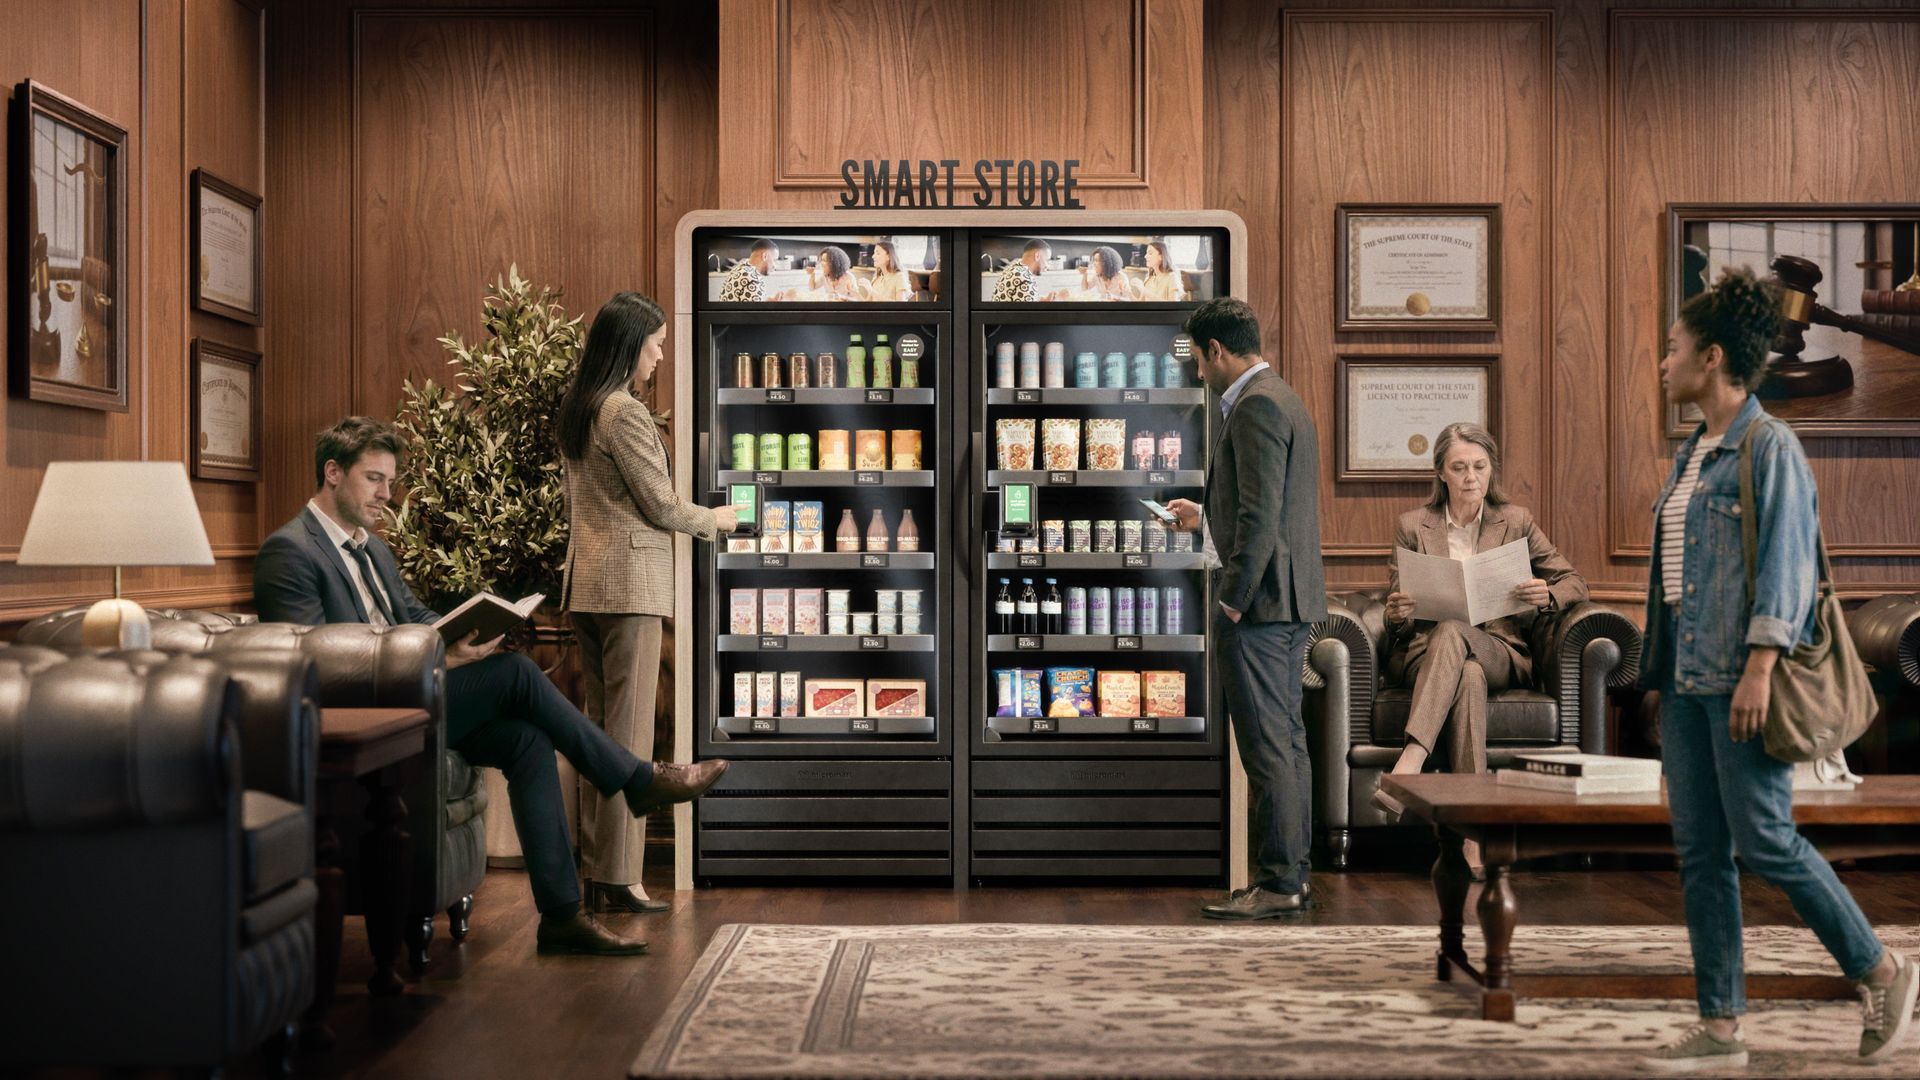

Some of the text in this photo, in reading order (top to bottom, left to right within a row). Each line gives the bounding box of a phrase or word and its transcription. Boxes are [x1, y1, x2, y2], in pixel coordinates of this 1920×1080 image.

[840, 159, 1080, 207] SMART STORE
[1363, 240, 1376, 249] THE
[1377, 233, 1406, 244] SUPREME
[1441, 235, 1453, 243] THE
[1454, 238, 1472, 249] STATE
[796, 519, 819, 529] TWIGZ
